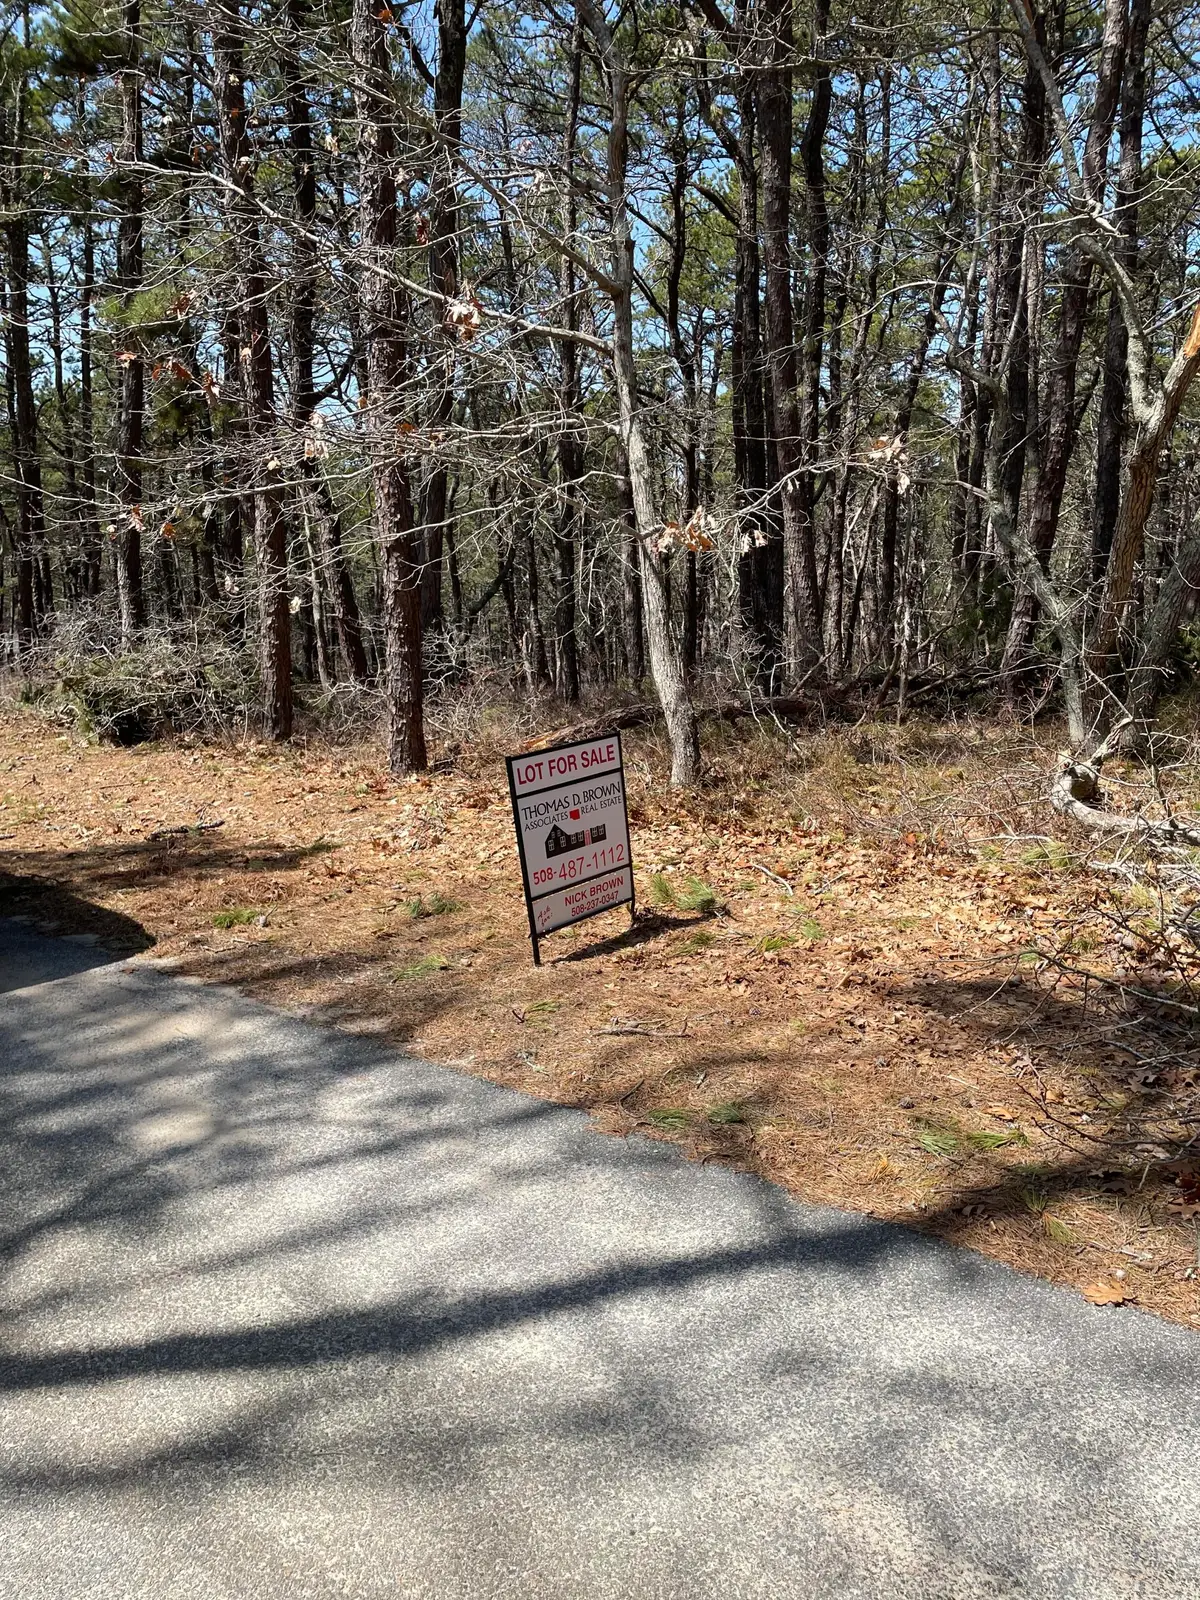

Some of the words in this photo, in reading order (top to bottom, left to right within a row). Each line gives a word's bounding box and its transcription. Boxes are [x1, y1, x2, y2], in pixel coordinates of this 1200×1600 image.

[516, 762, 543, 785] LOT
[548, 754, 577, 777] FOR
[580, 744, 615, 768] SALE
[521, 796, 570, 820] THOMAS
[572, 794, 582, 807] D.
[582, 781, 621, 804] BROWN
[524, 811, 569, 832] ASSOCIATES
[580, 803, 598, 815] REAL
[600, 795, 622, 808] ESTATE
[533, 843, 625, 885] 508-487-1112
[564, 890, 588, 906] NICK
[590, 876, 624, 897] BROWN
[571, 890, 619, 917] 508-237-0347
